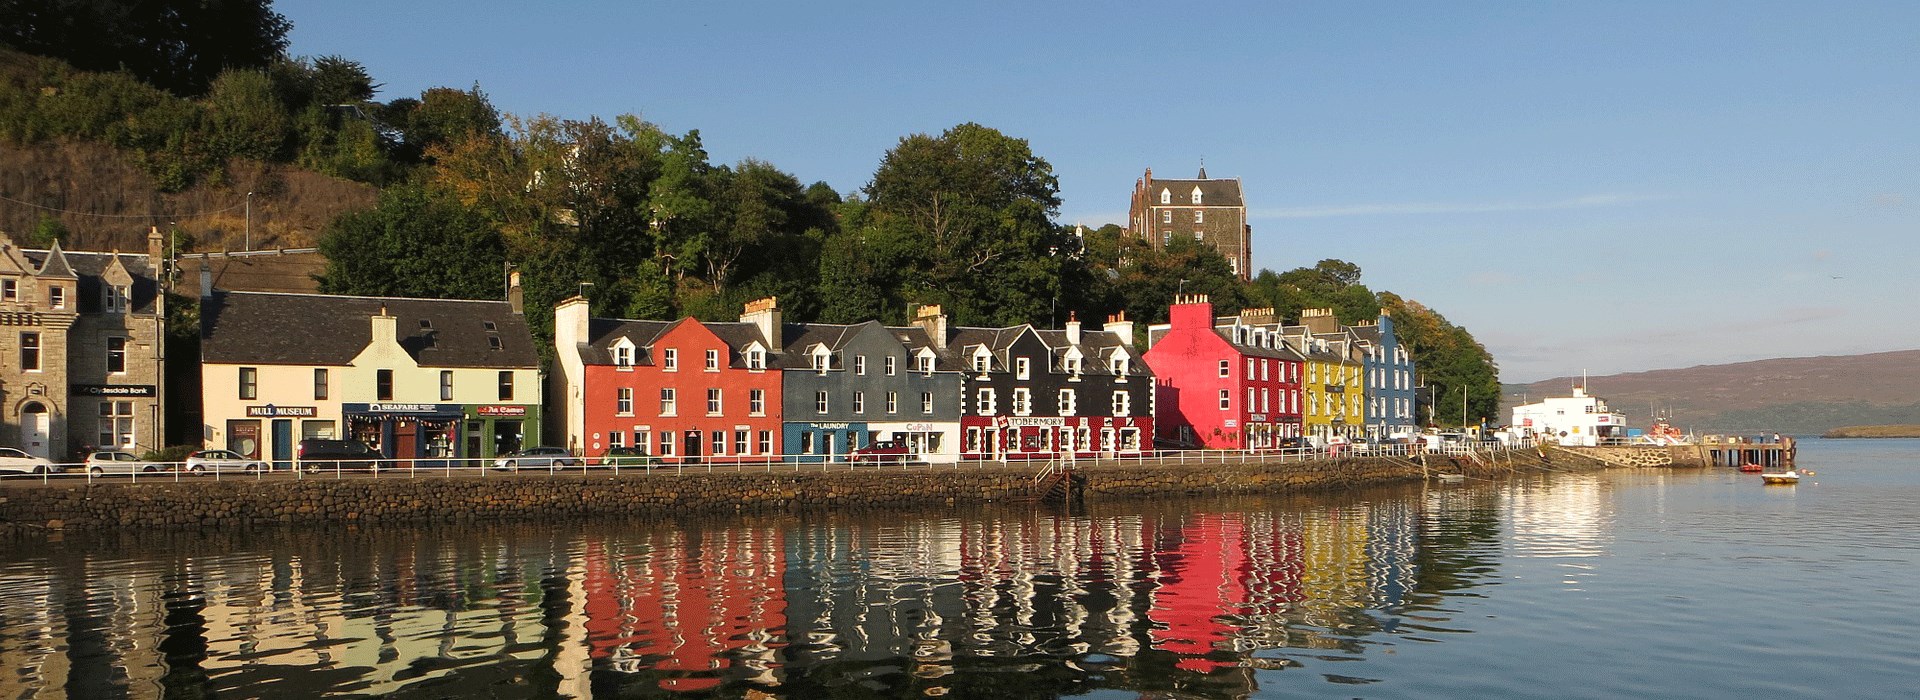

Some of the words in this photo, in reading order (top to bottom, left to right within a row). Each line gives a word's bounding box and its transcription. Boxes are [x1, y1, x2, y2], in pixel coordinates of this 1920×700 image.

[90, 387, 129, 395] Clydesdale
[250, 407, 273, 416] MULL
[275, 407, 313, 416] MUSEUM
[1010, 417, 1064, 426] TOBERMORY
[820, 422, 849, 430] LAUNDRY
